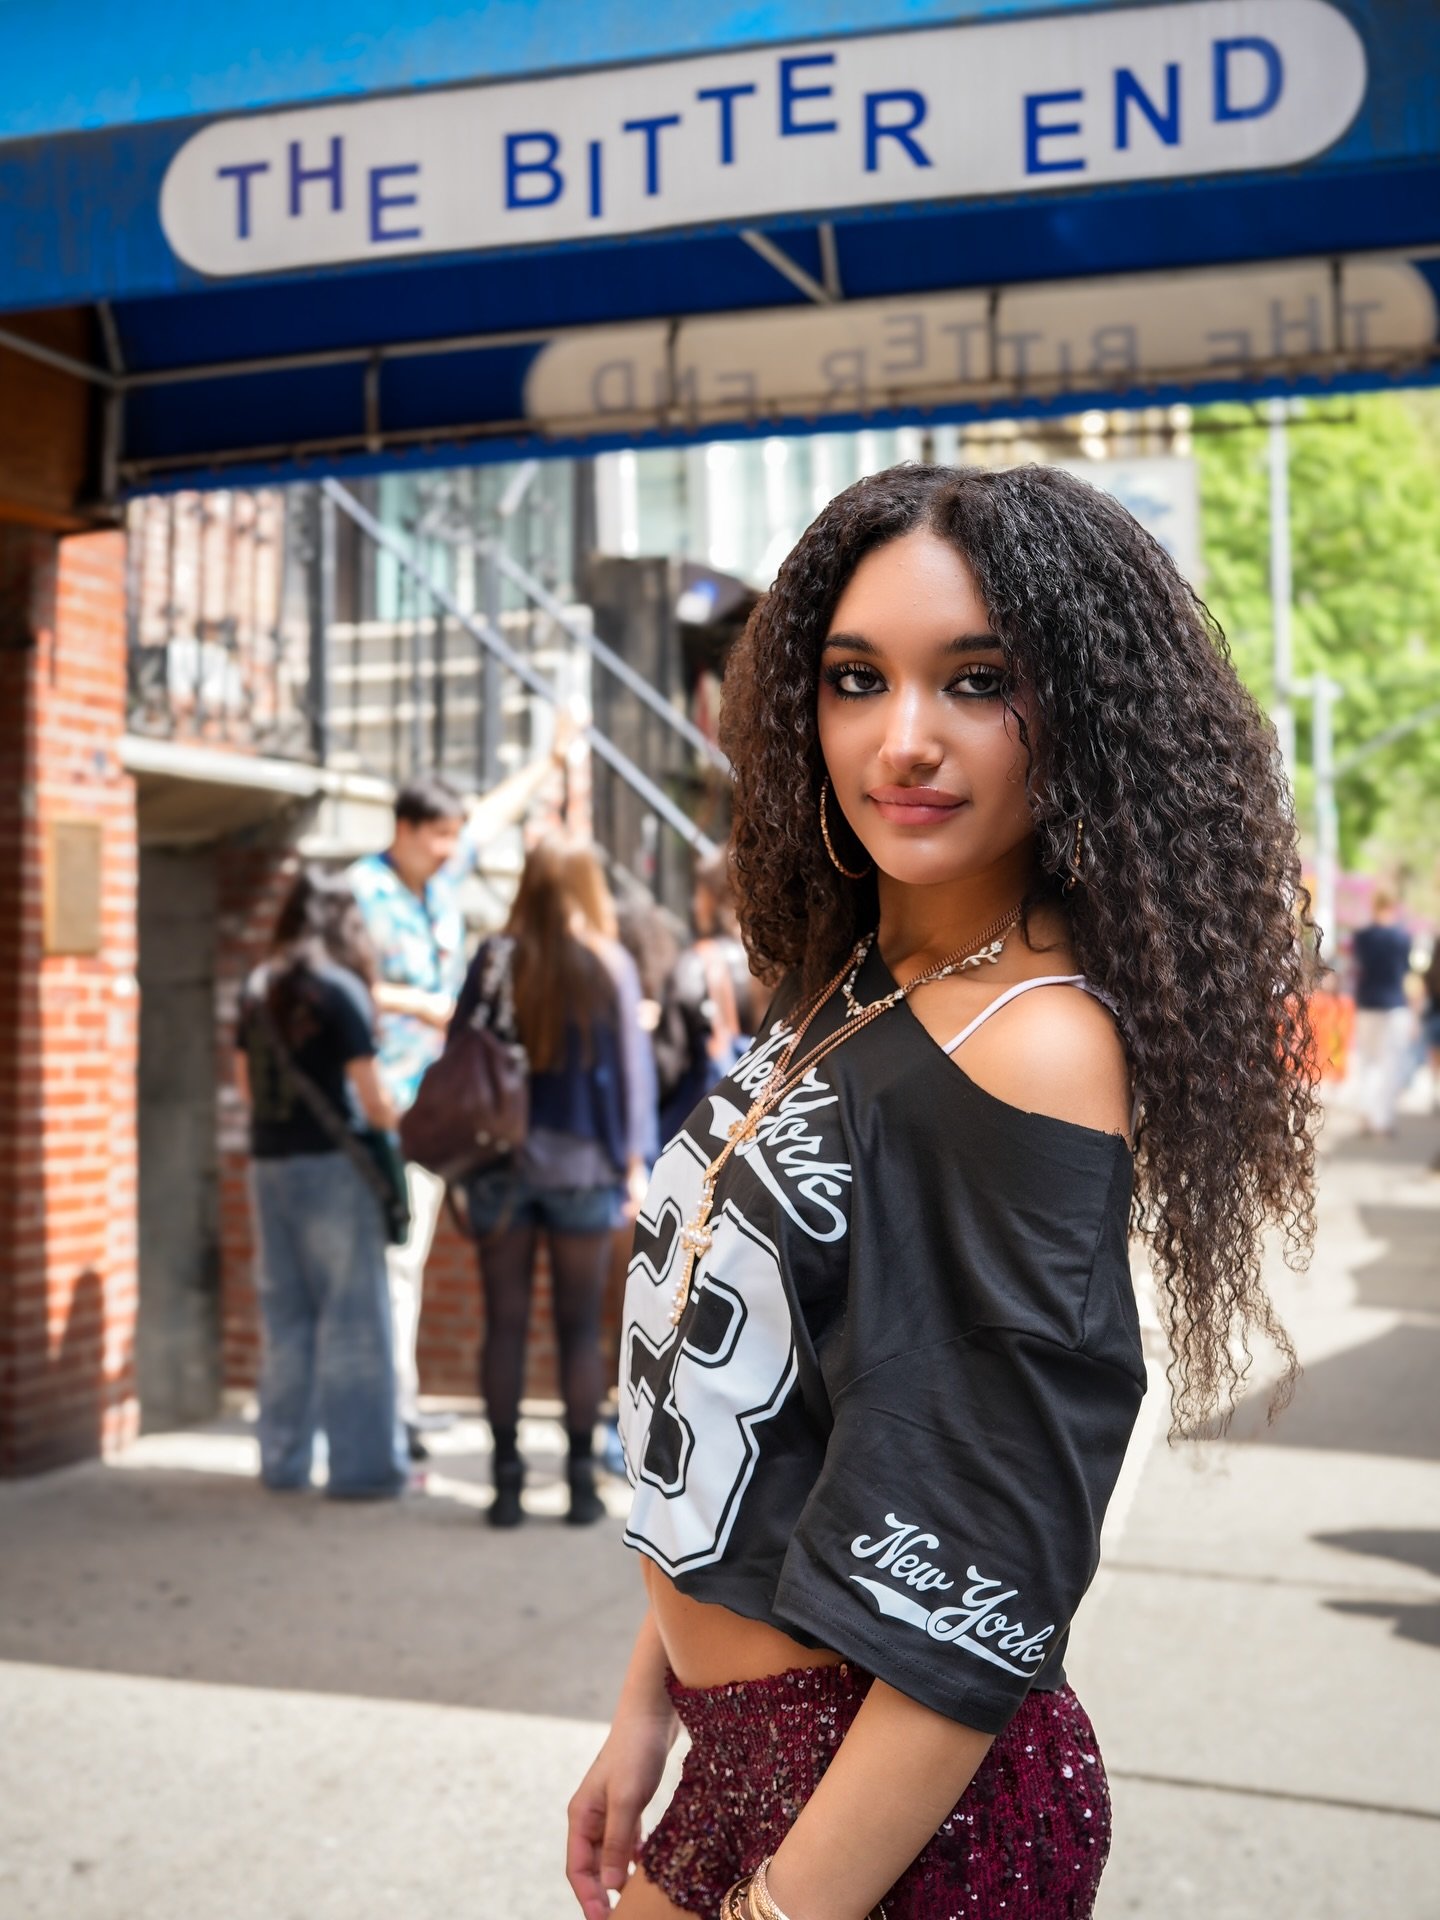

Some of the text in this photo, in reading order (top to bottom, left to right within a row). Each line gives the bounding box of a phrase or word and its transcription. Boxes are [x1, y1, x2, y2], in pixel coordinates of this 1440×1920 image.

[217, 35, 1284, 245] THE BITTER END
[733, 1067, 852, 1204] York
[850, 1512, 1055, 1664] New York
